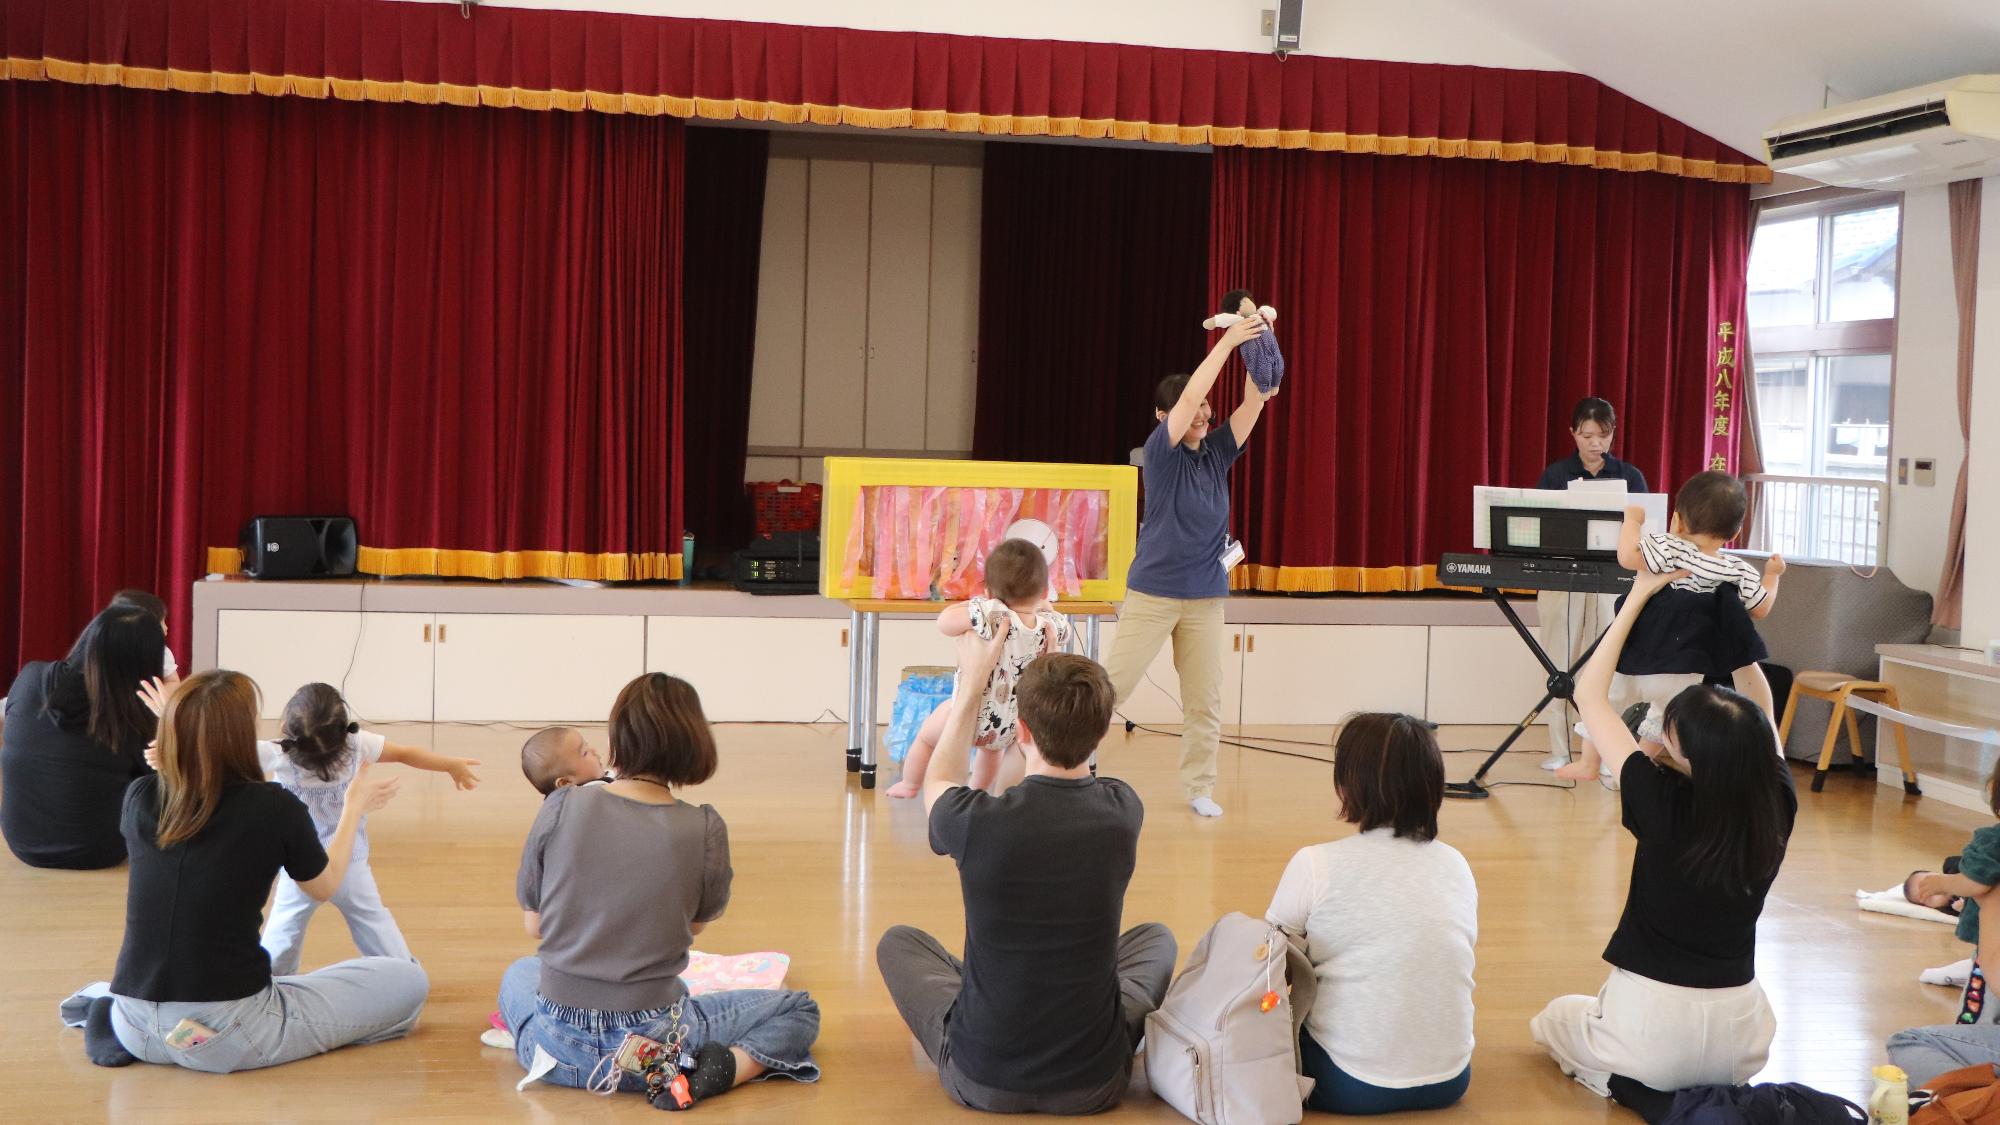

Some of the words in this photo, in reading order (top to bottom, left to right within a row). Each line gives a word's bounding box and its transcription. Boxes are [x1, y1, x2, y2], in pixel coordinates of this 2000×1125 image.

[1711, 321, 1736, 436] 平成八年度
[1457, 563, 1492, 575] YAMAHA
